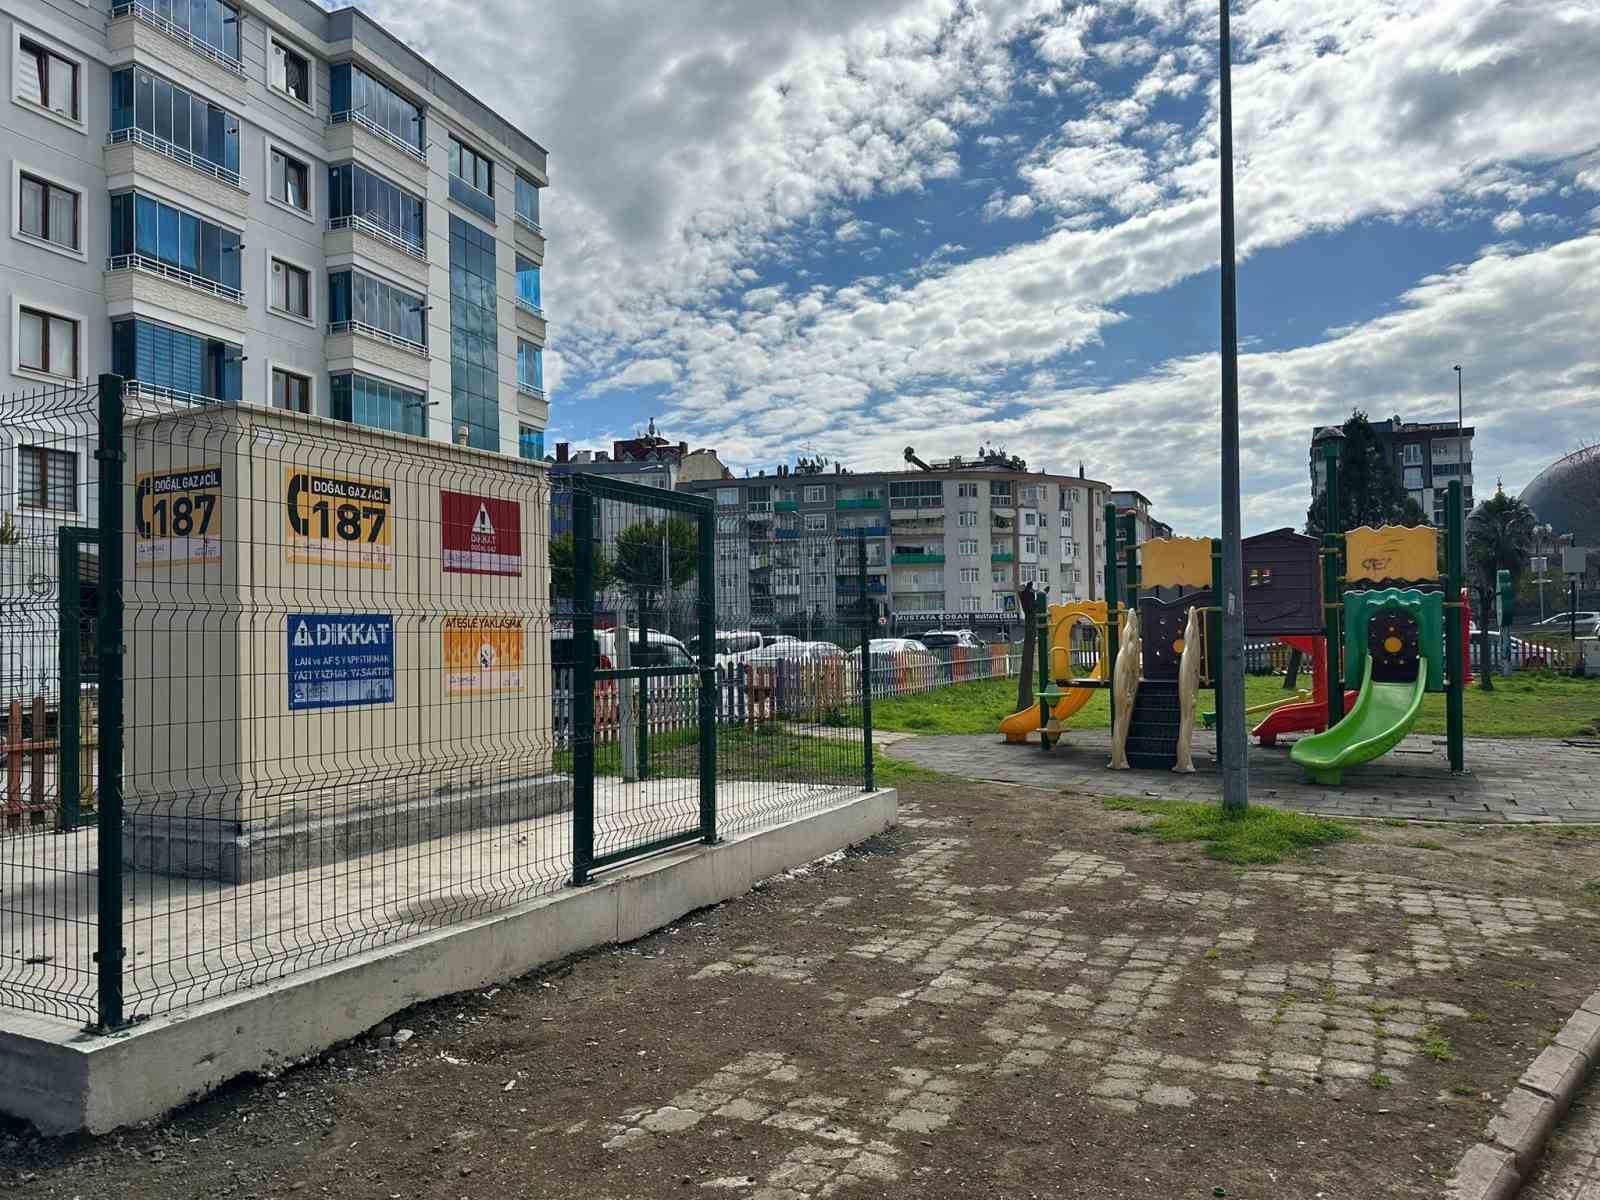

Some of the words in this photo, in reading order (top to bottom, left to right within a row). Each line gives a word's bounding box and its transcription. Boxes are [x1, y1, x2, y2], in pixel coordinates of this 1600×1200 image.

[182, 474, 198, 488] GAZ
[314, 480, 346, 495] DOĞAL
[348, 486, 366, 498] GAZ
[153, 495, 215, 537] 187
[313, 501, 385, 542] 187
